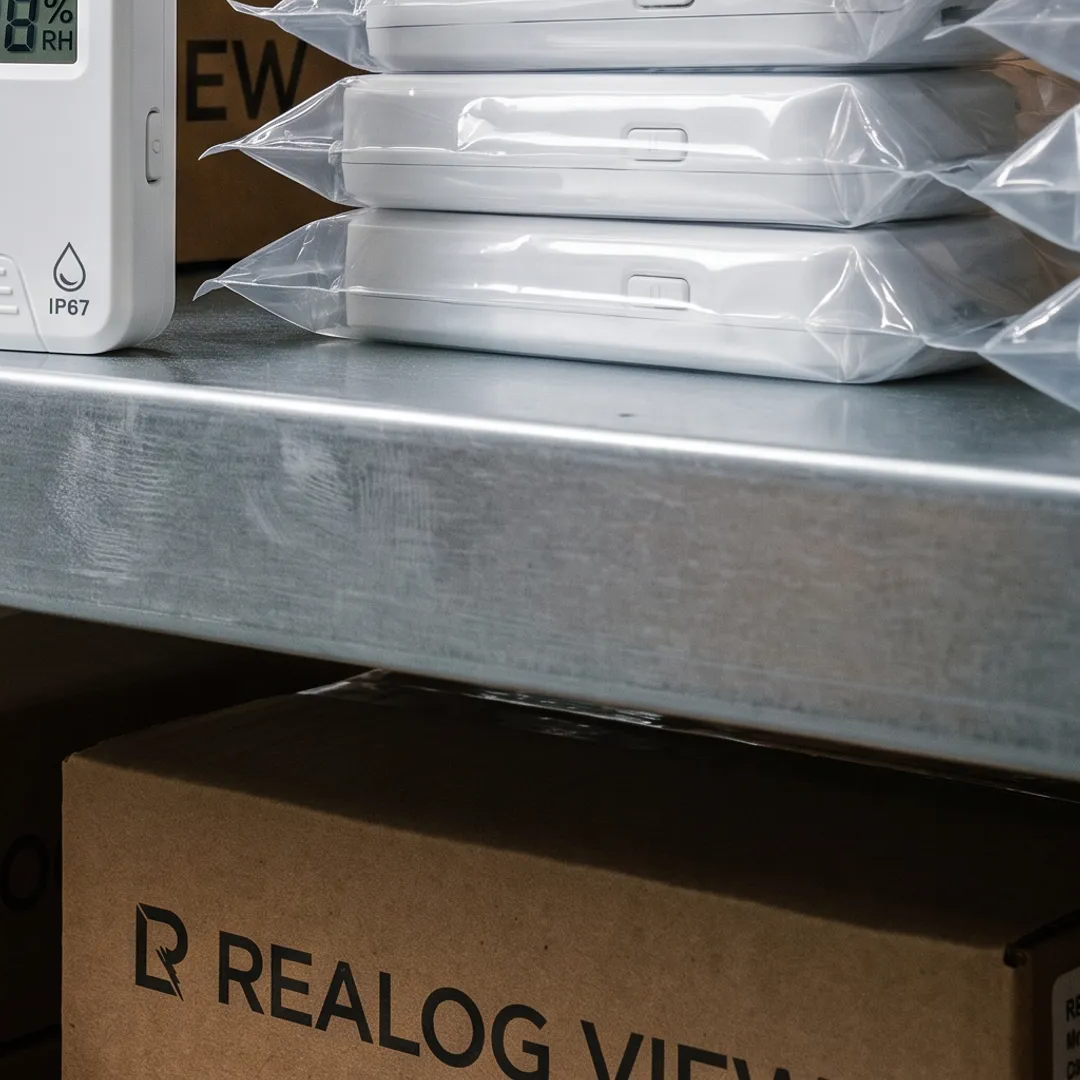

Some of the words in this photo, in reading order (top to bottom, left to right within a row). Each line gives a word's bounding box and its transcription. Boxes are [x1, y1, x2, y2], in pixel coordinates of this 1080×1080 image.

[42, 30, 73, 51] RH
[185, 37, 308, 123] EW
[48, 298, 90, 317] IP67
[219, 930, 550, 1080] REALOG
